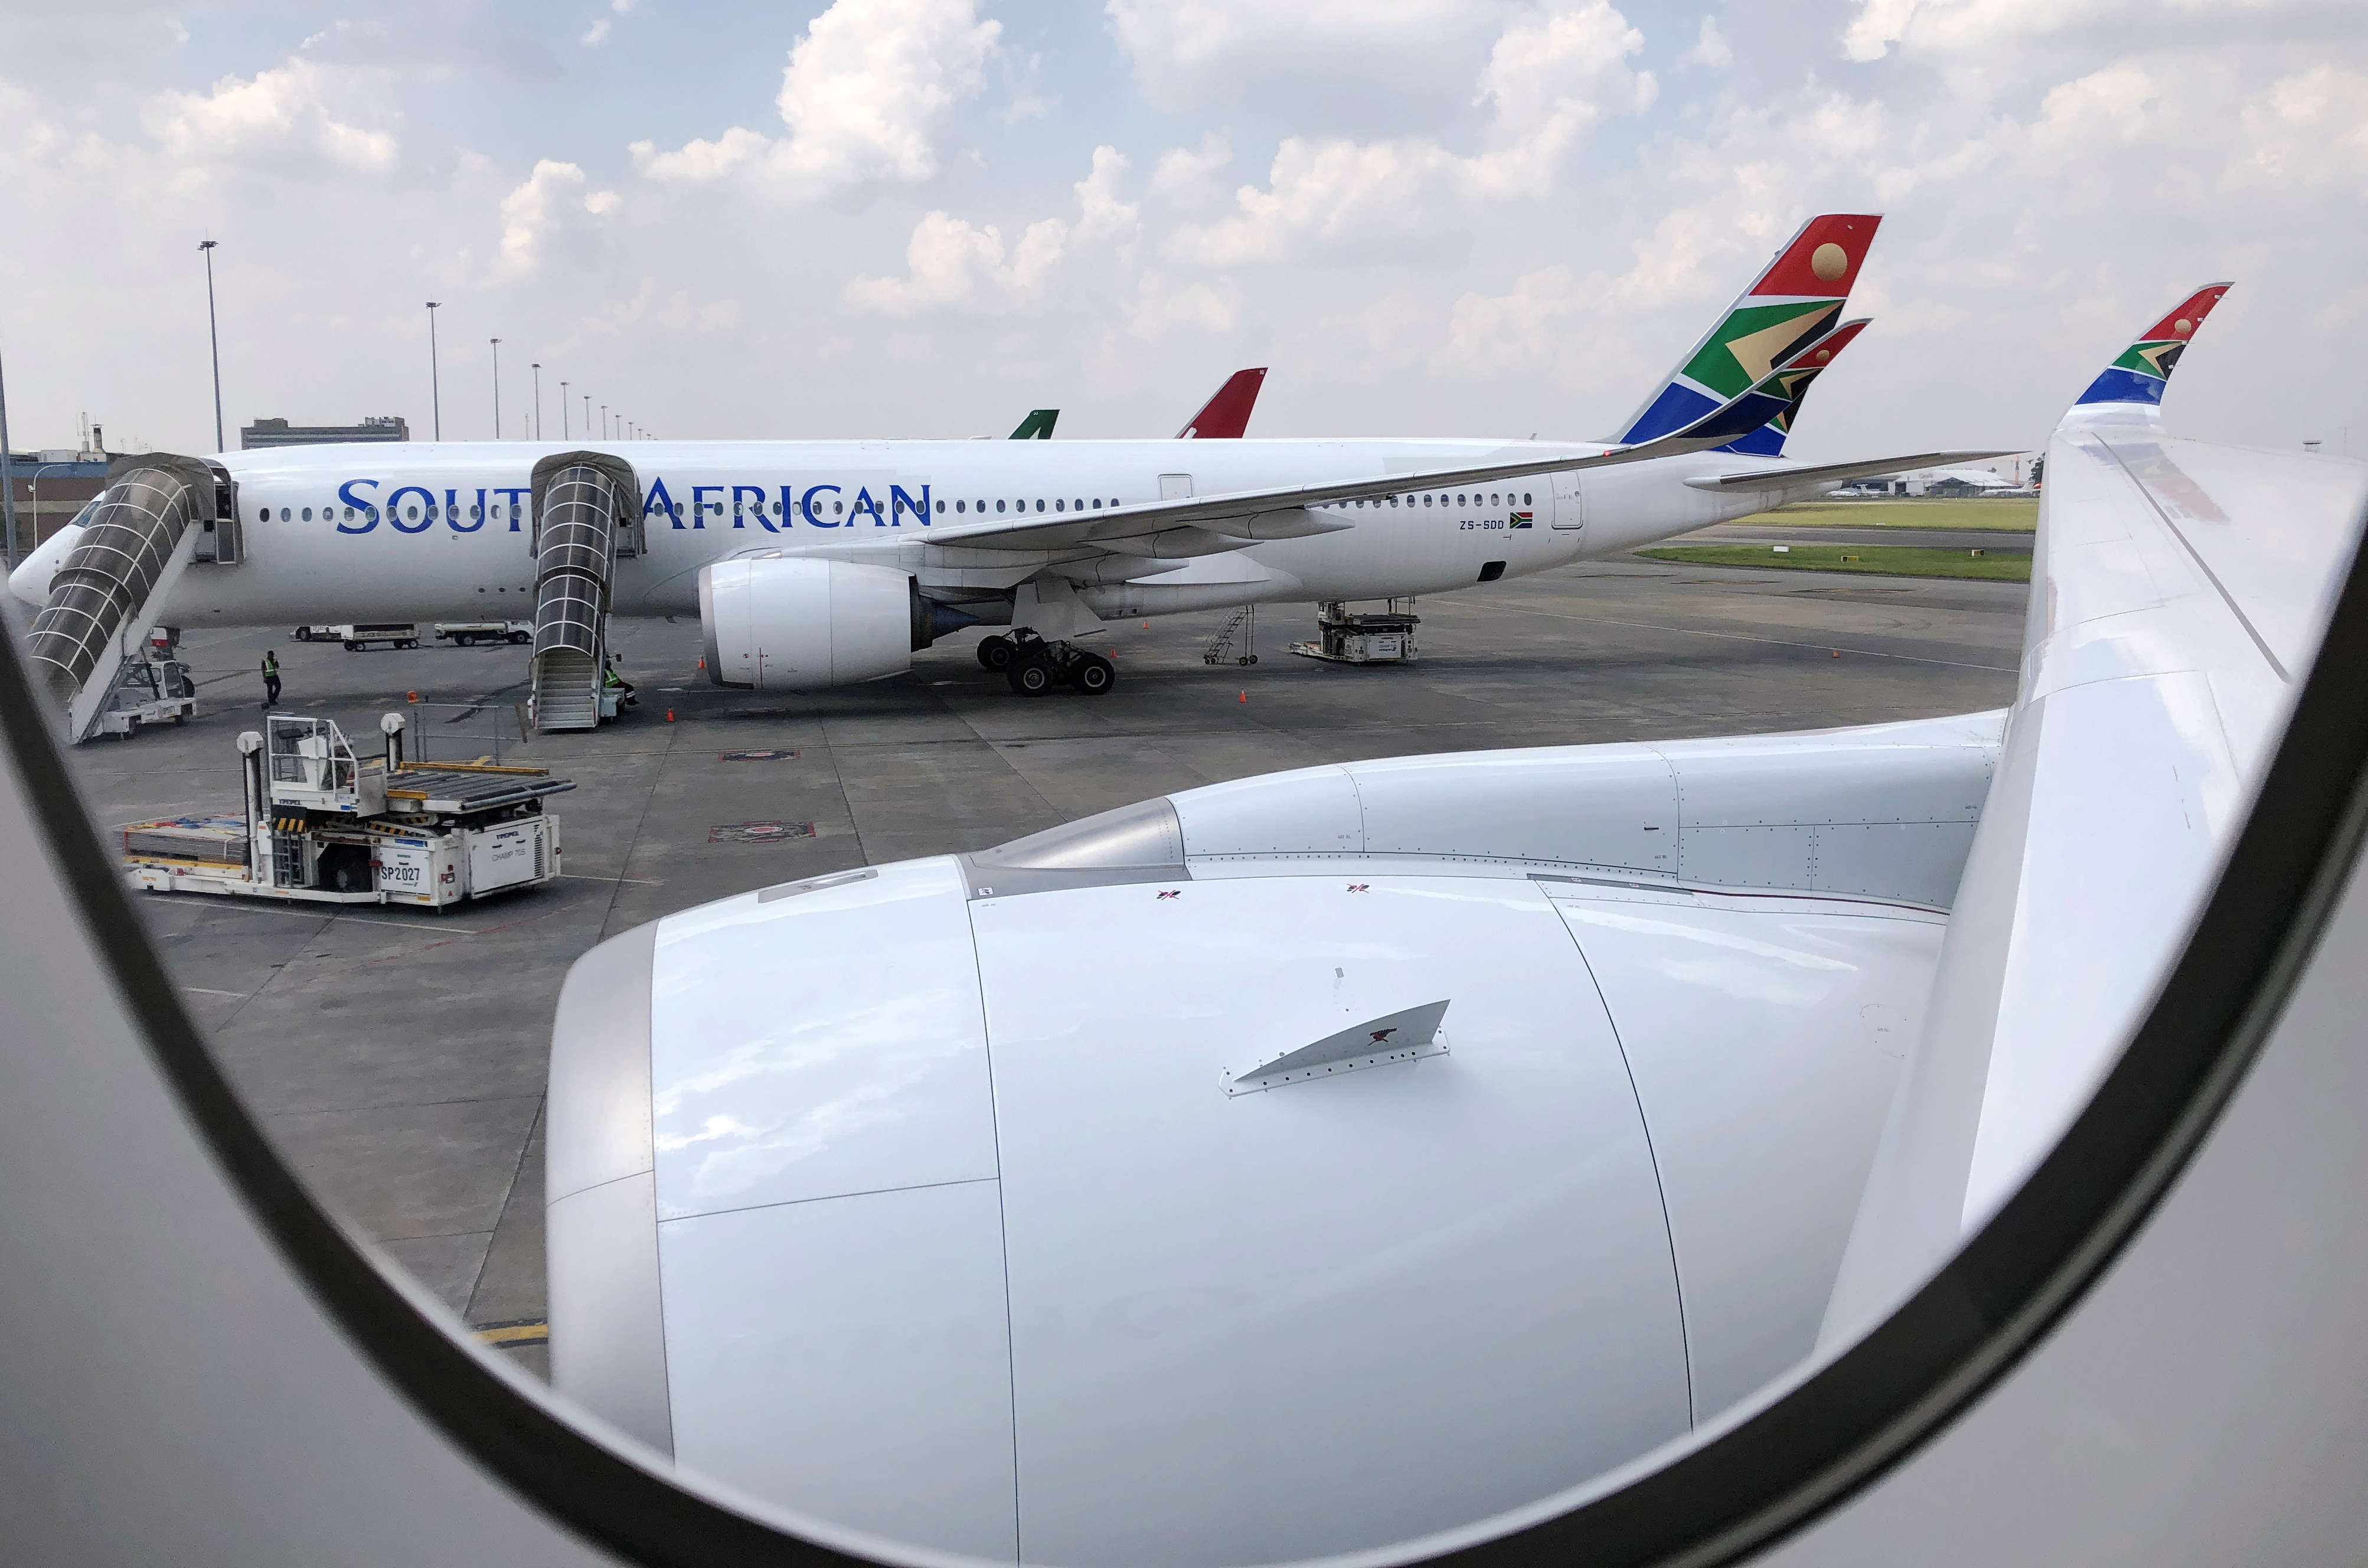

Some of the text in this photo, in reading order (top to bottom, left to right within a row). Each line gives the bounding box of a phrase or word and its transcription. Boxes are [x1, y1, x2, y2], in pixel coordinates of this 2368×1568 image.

[337, 476, 931, 534] SOUT AFRICAN
[1459, 520, 1504, 530] ZS-SDD
[381, 866, 420, 881] SP2027
